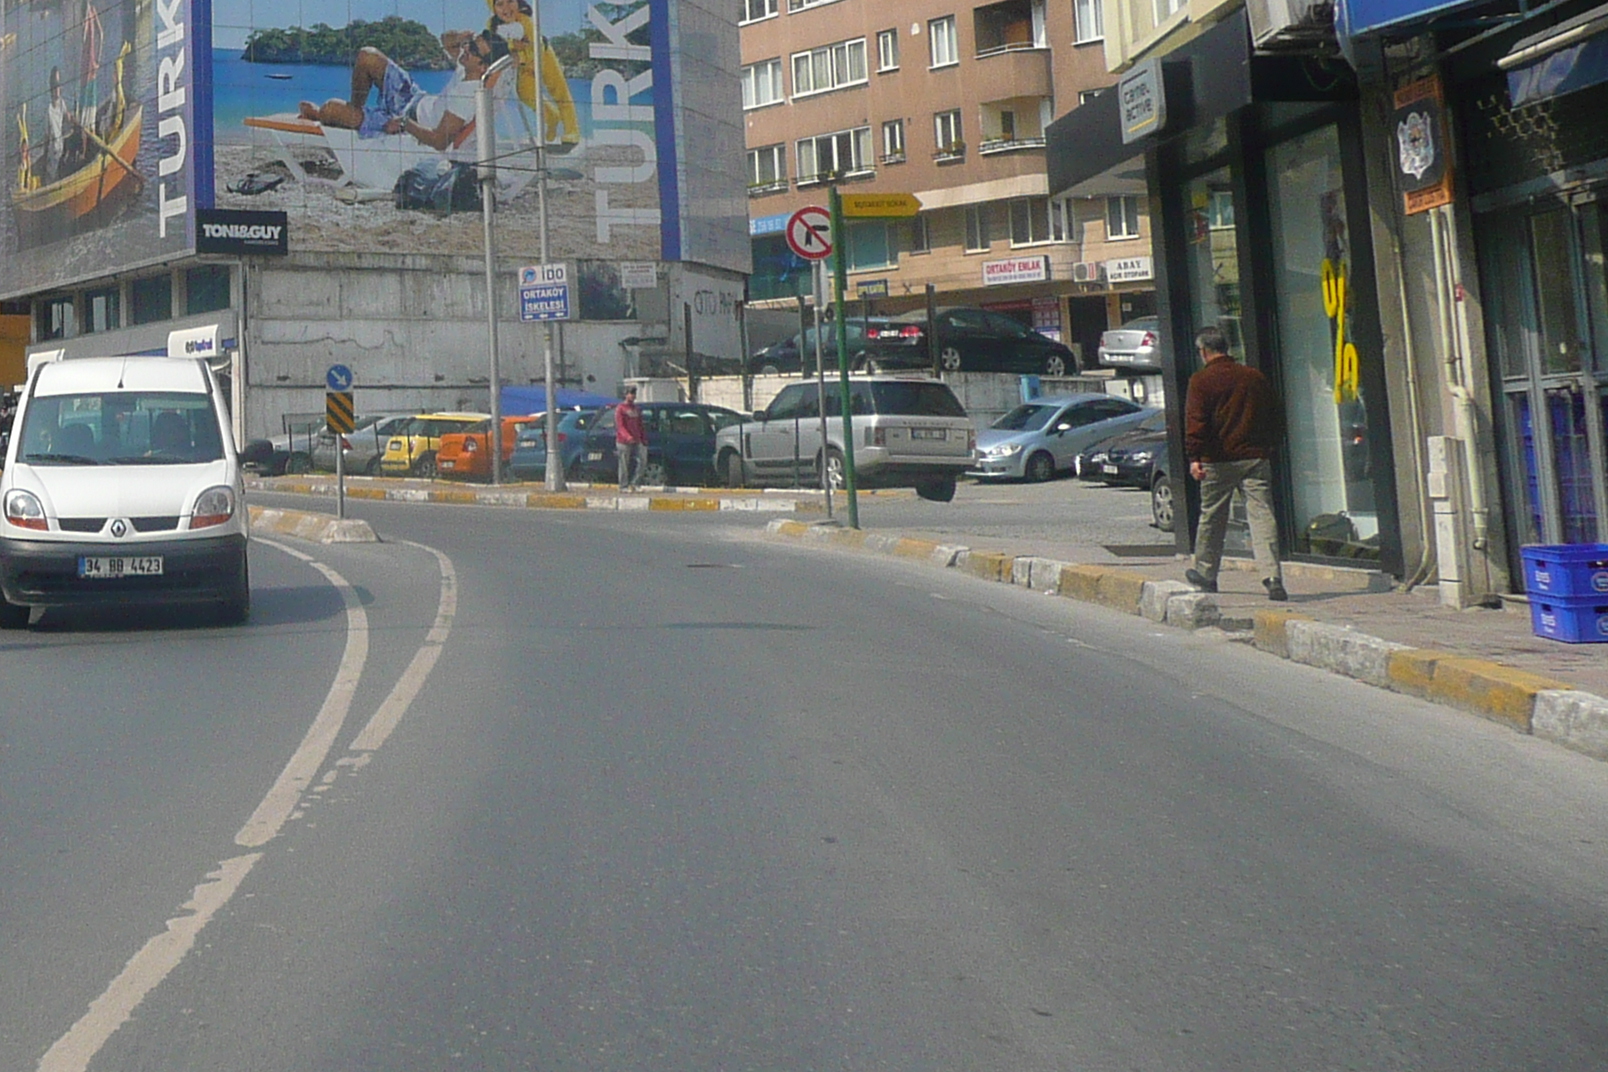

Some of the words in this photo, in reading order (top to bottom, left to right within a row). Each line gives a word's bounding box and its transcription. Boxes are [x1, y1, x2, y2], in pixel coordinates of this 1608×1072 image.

[1124, 83, 1150, 105] camel
[1127, 97, 1152, 122] active
[202, 224, 281, 239] TONI&GUY
[523, 288, 564, 300] ORTAKÖY
[525, 299, 565, 312] İSKELESİ
[86, 559, 101, 573] 34
[131, 559, 161, 573] 4423
